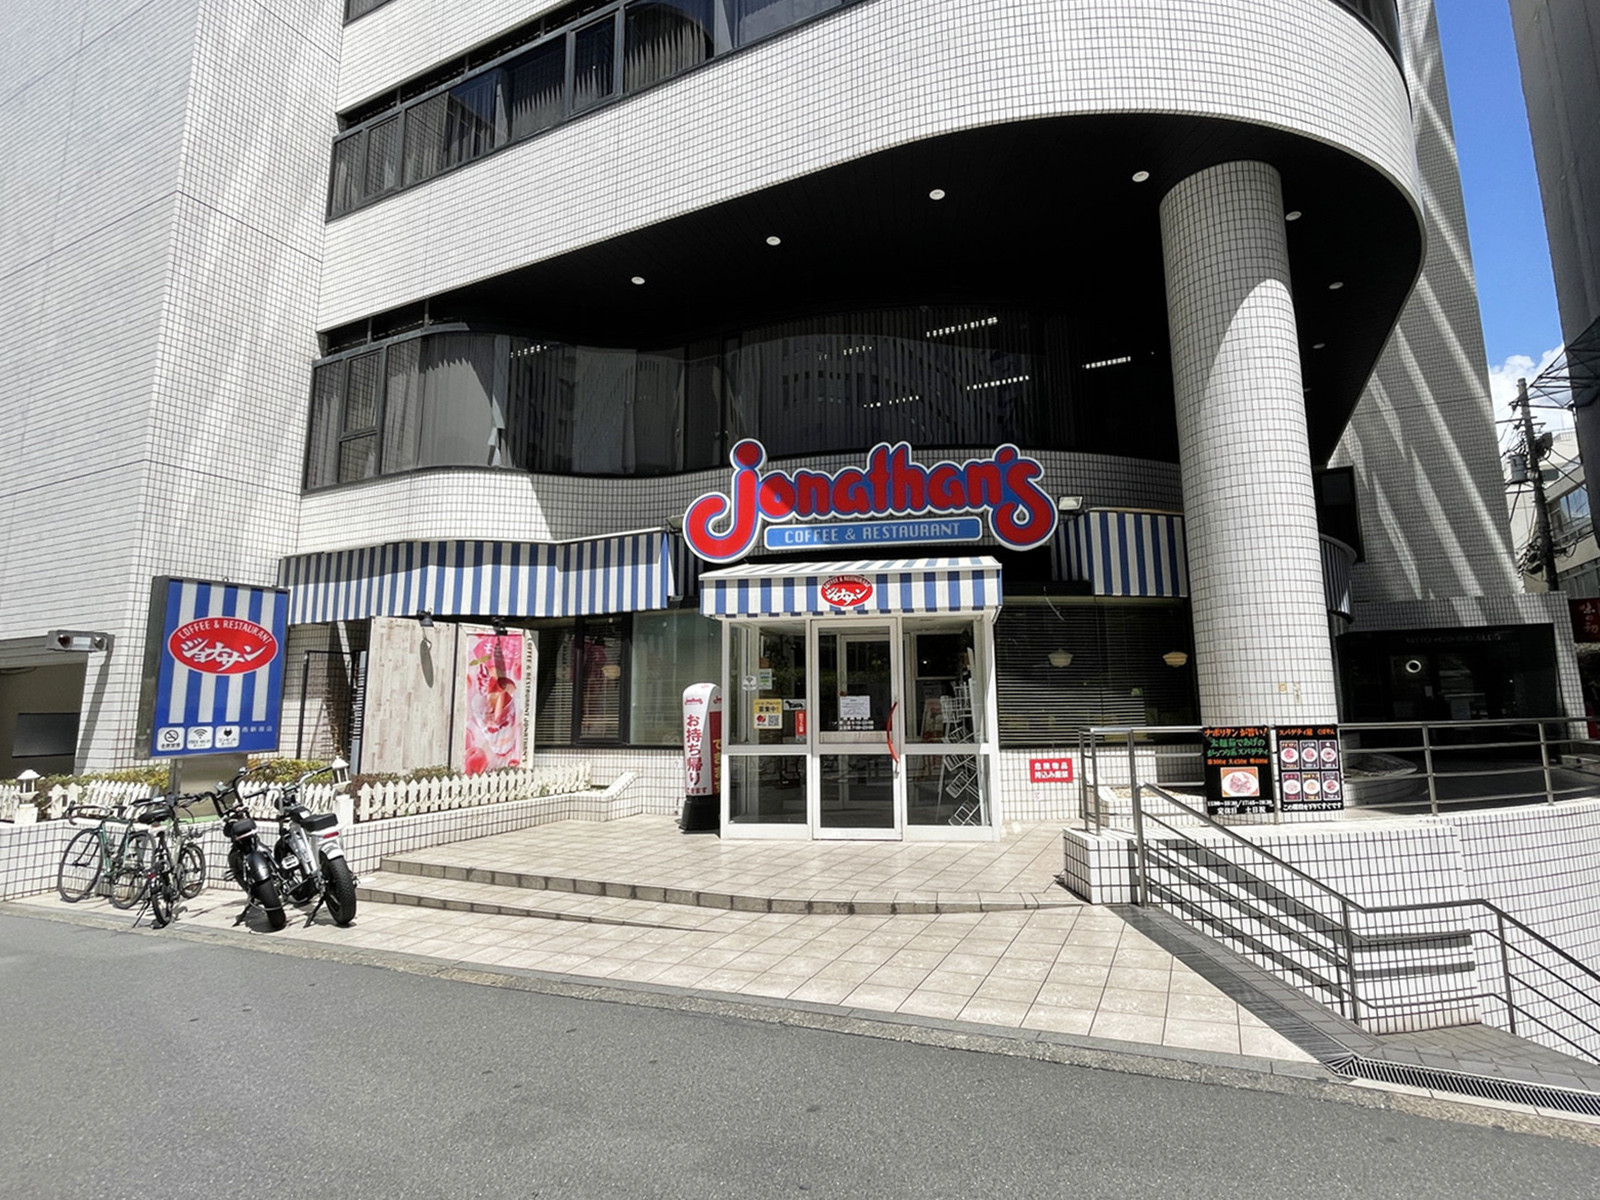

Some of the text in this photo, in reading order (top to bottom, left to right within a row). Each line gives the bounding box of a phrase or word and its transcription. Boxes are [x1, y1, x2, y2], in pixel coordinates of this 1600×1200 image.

[784, 522, 961, 545] COFFEE & RESTAURANT
[822, 577, 839, 590] COFFEE
[843, 576, 871, 588] RESTAURANT
[825, 587, 868, 606] ジョナサン
[177, 619, 273, 644] COFFEE & RESTAURANT
[180, 637, 268, 672] ジョナサン
[686, 714, 703, 786] お持ち帰り
[1217, 806, 1238, 815] 定休日
